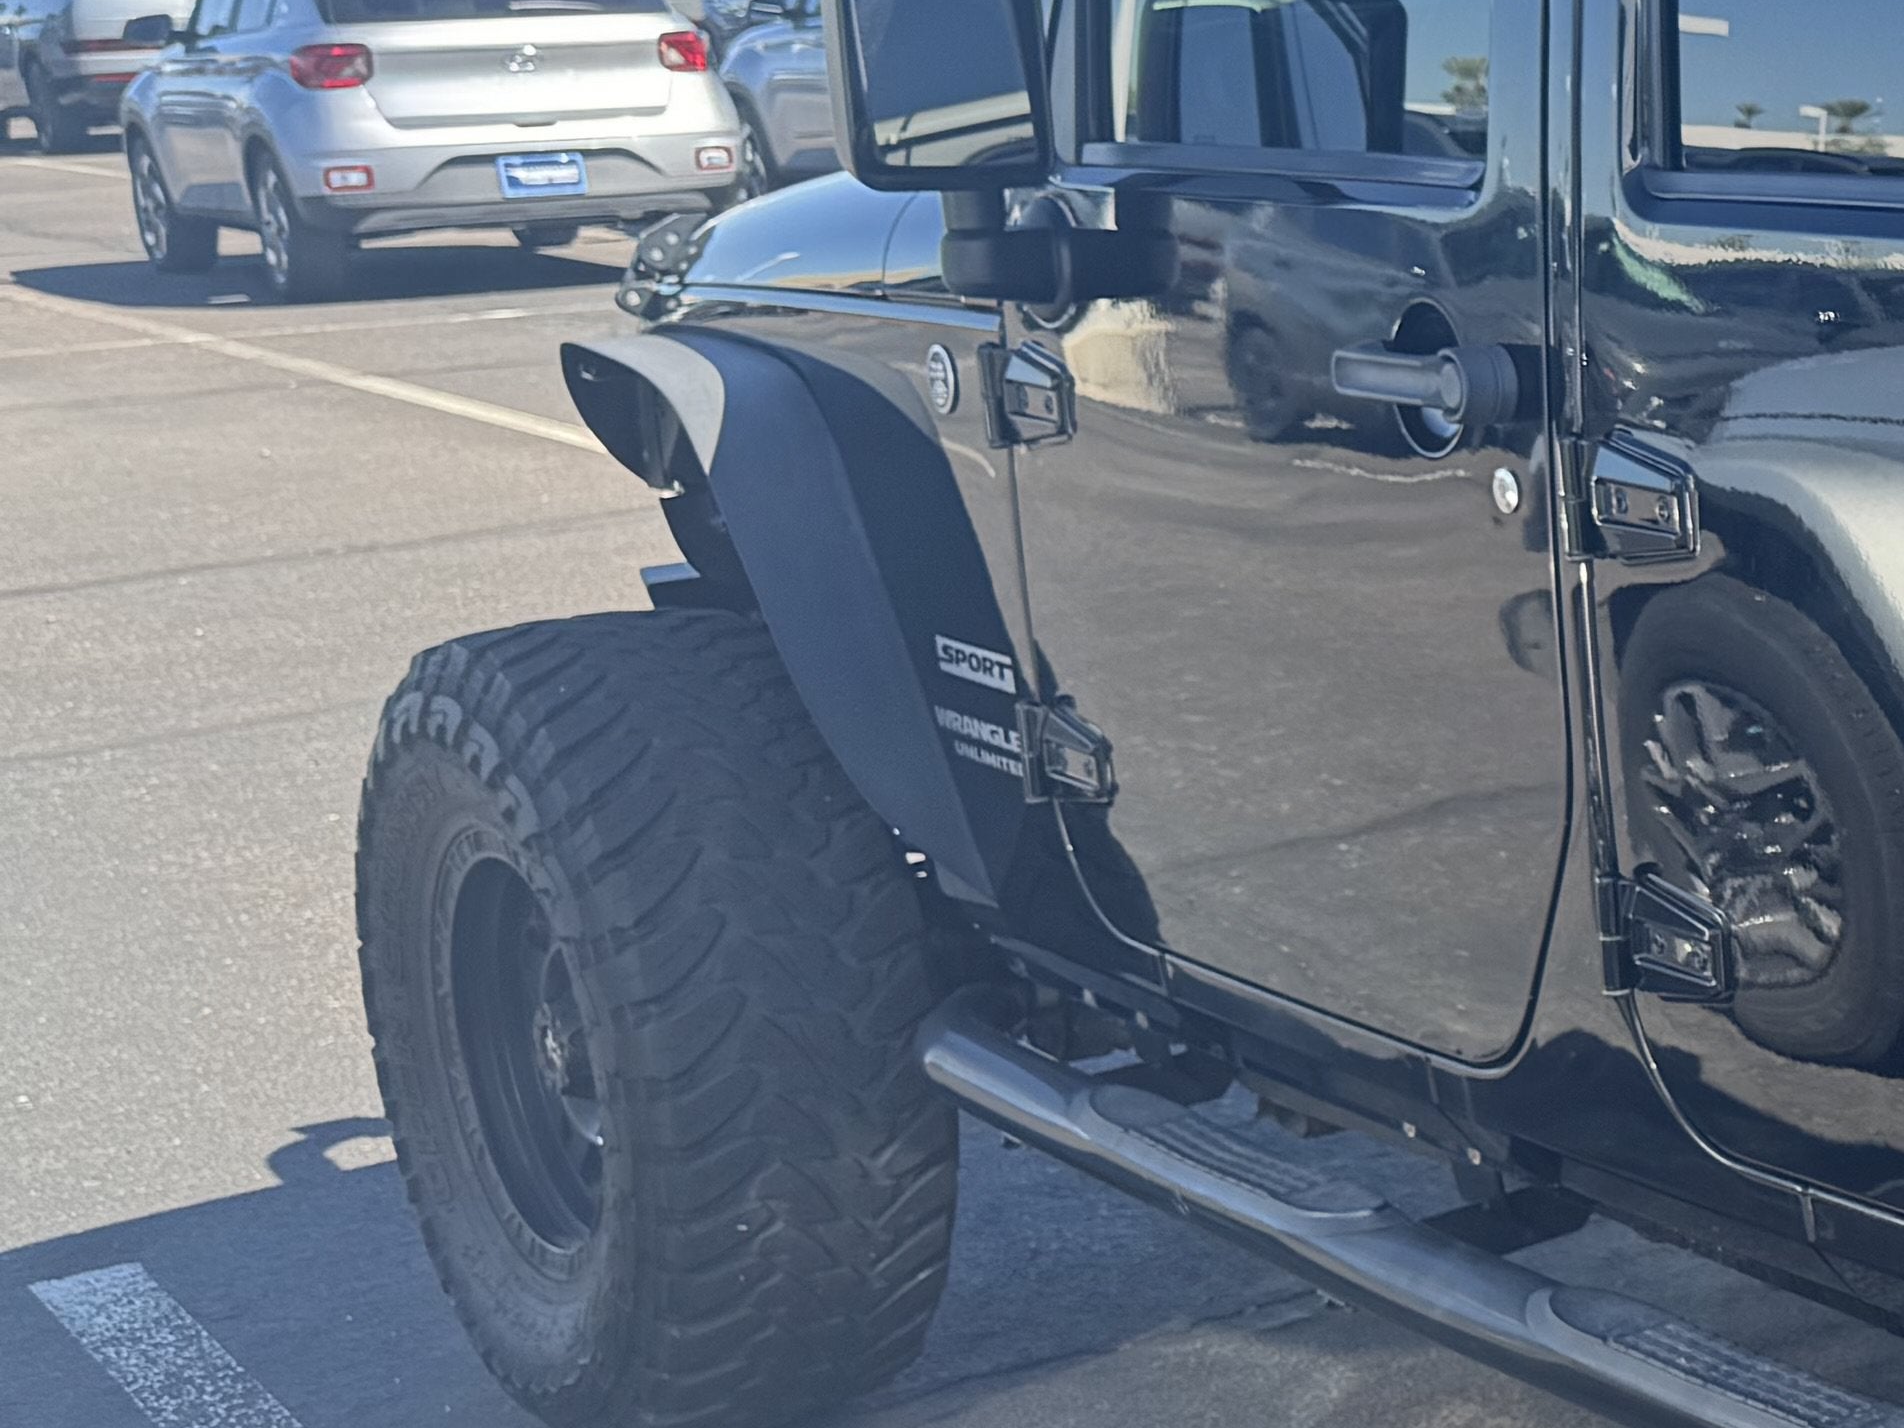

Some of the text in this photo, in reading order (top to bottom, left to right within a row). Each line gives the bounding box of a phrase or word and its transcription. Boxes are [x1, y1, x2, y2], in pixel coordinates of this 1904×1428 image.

[939, 643, 1013, 681] SPORT
[934, 705, 1022, 753] WRANGLE
[954, 739, 1024, 777] UNLIMITE
